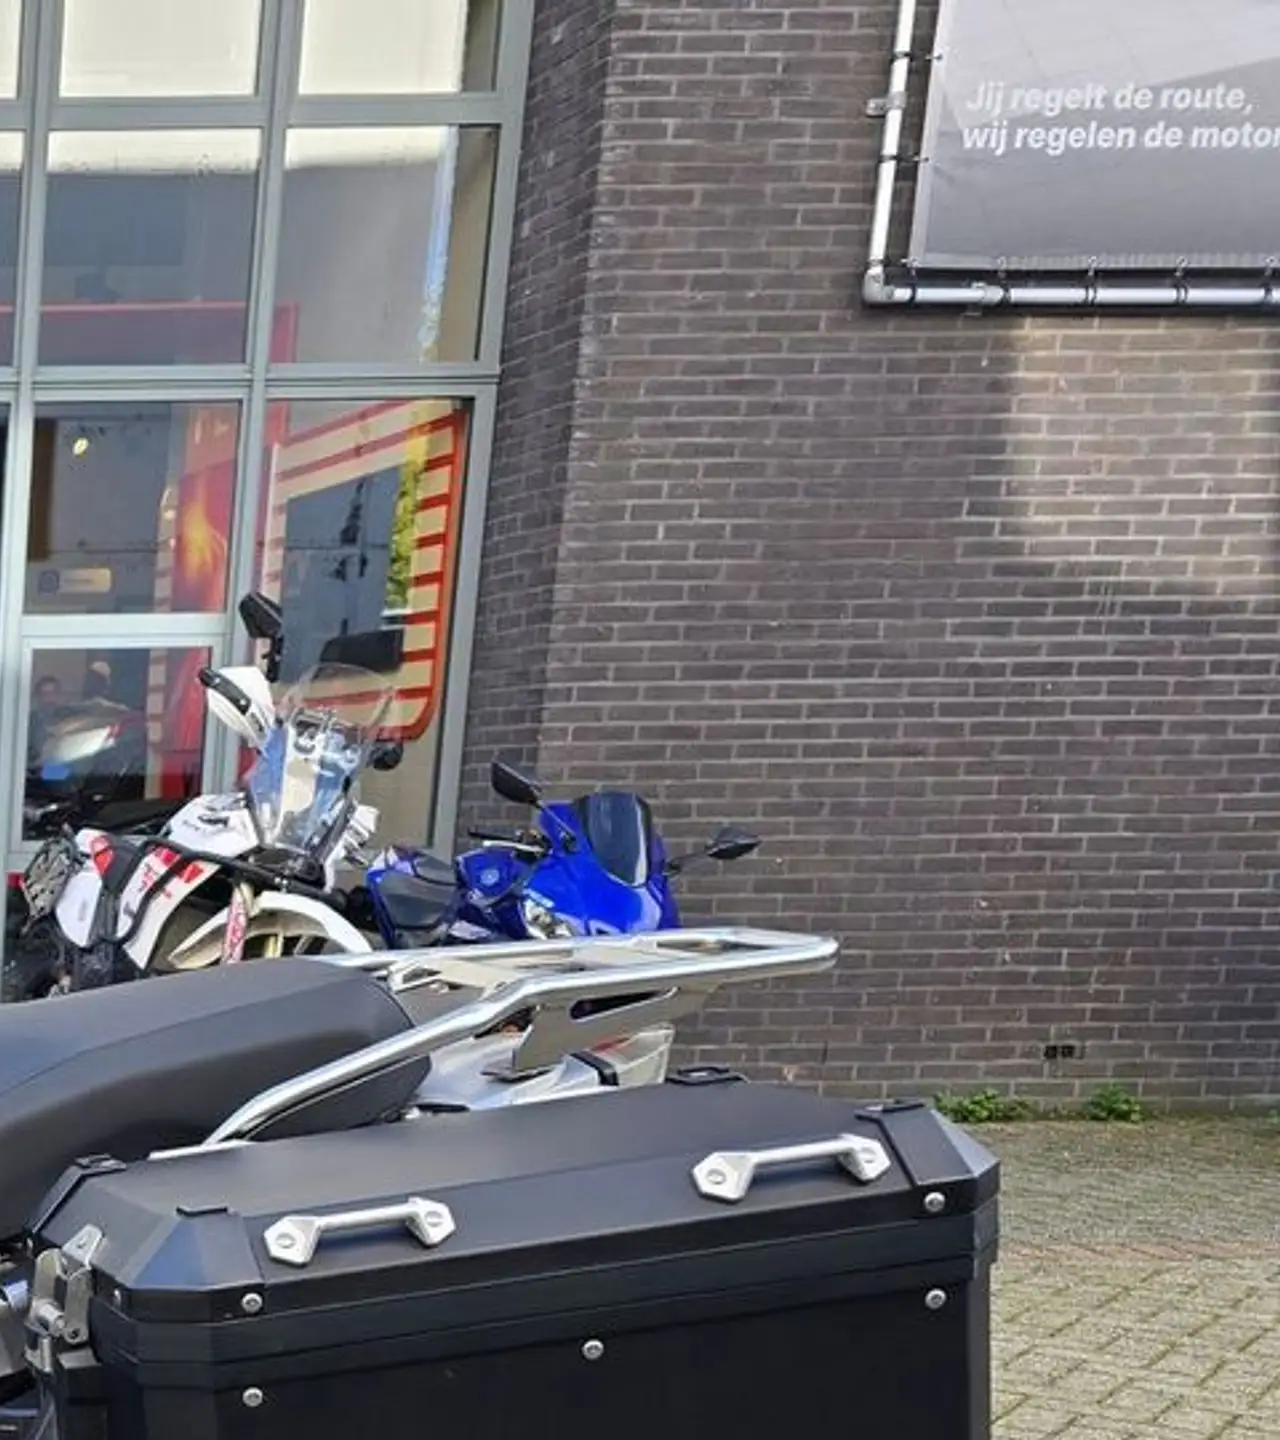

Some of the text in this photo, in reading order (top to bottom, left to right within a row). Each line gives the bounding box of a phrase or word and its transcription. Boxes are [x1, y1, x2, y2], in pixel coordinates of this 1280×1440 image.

[967, 81, 1254, 116] Jij regelt de route,
[961, 119, 1010, 156] wij
[1014, 119, 1137, 156] regelen
[1143, 119, 1184, 149] de
